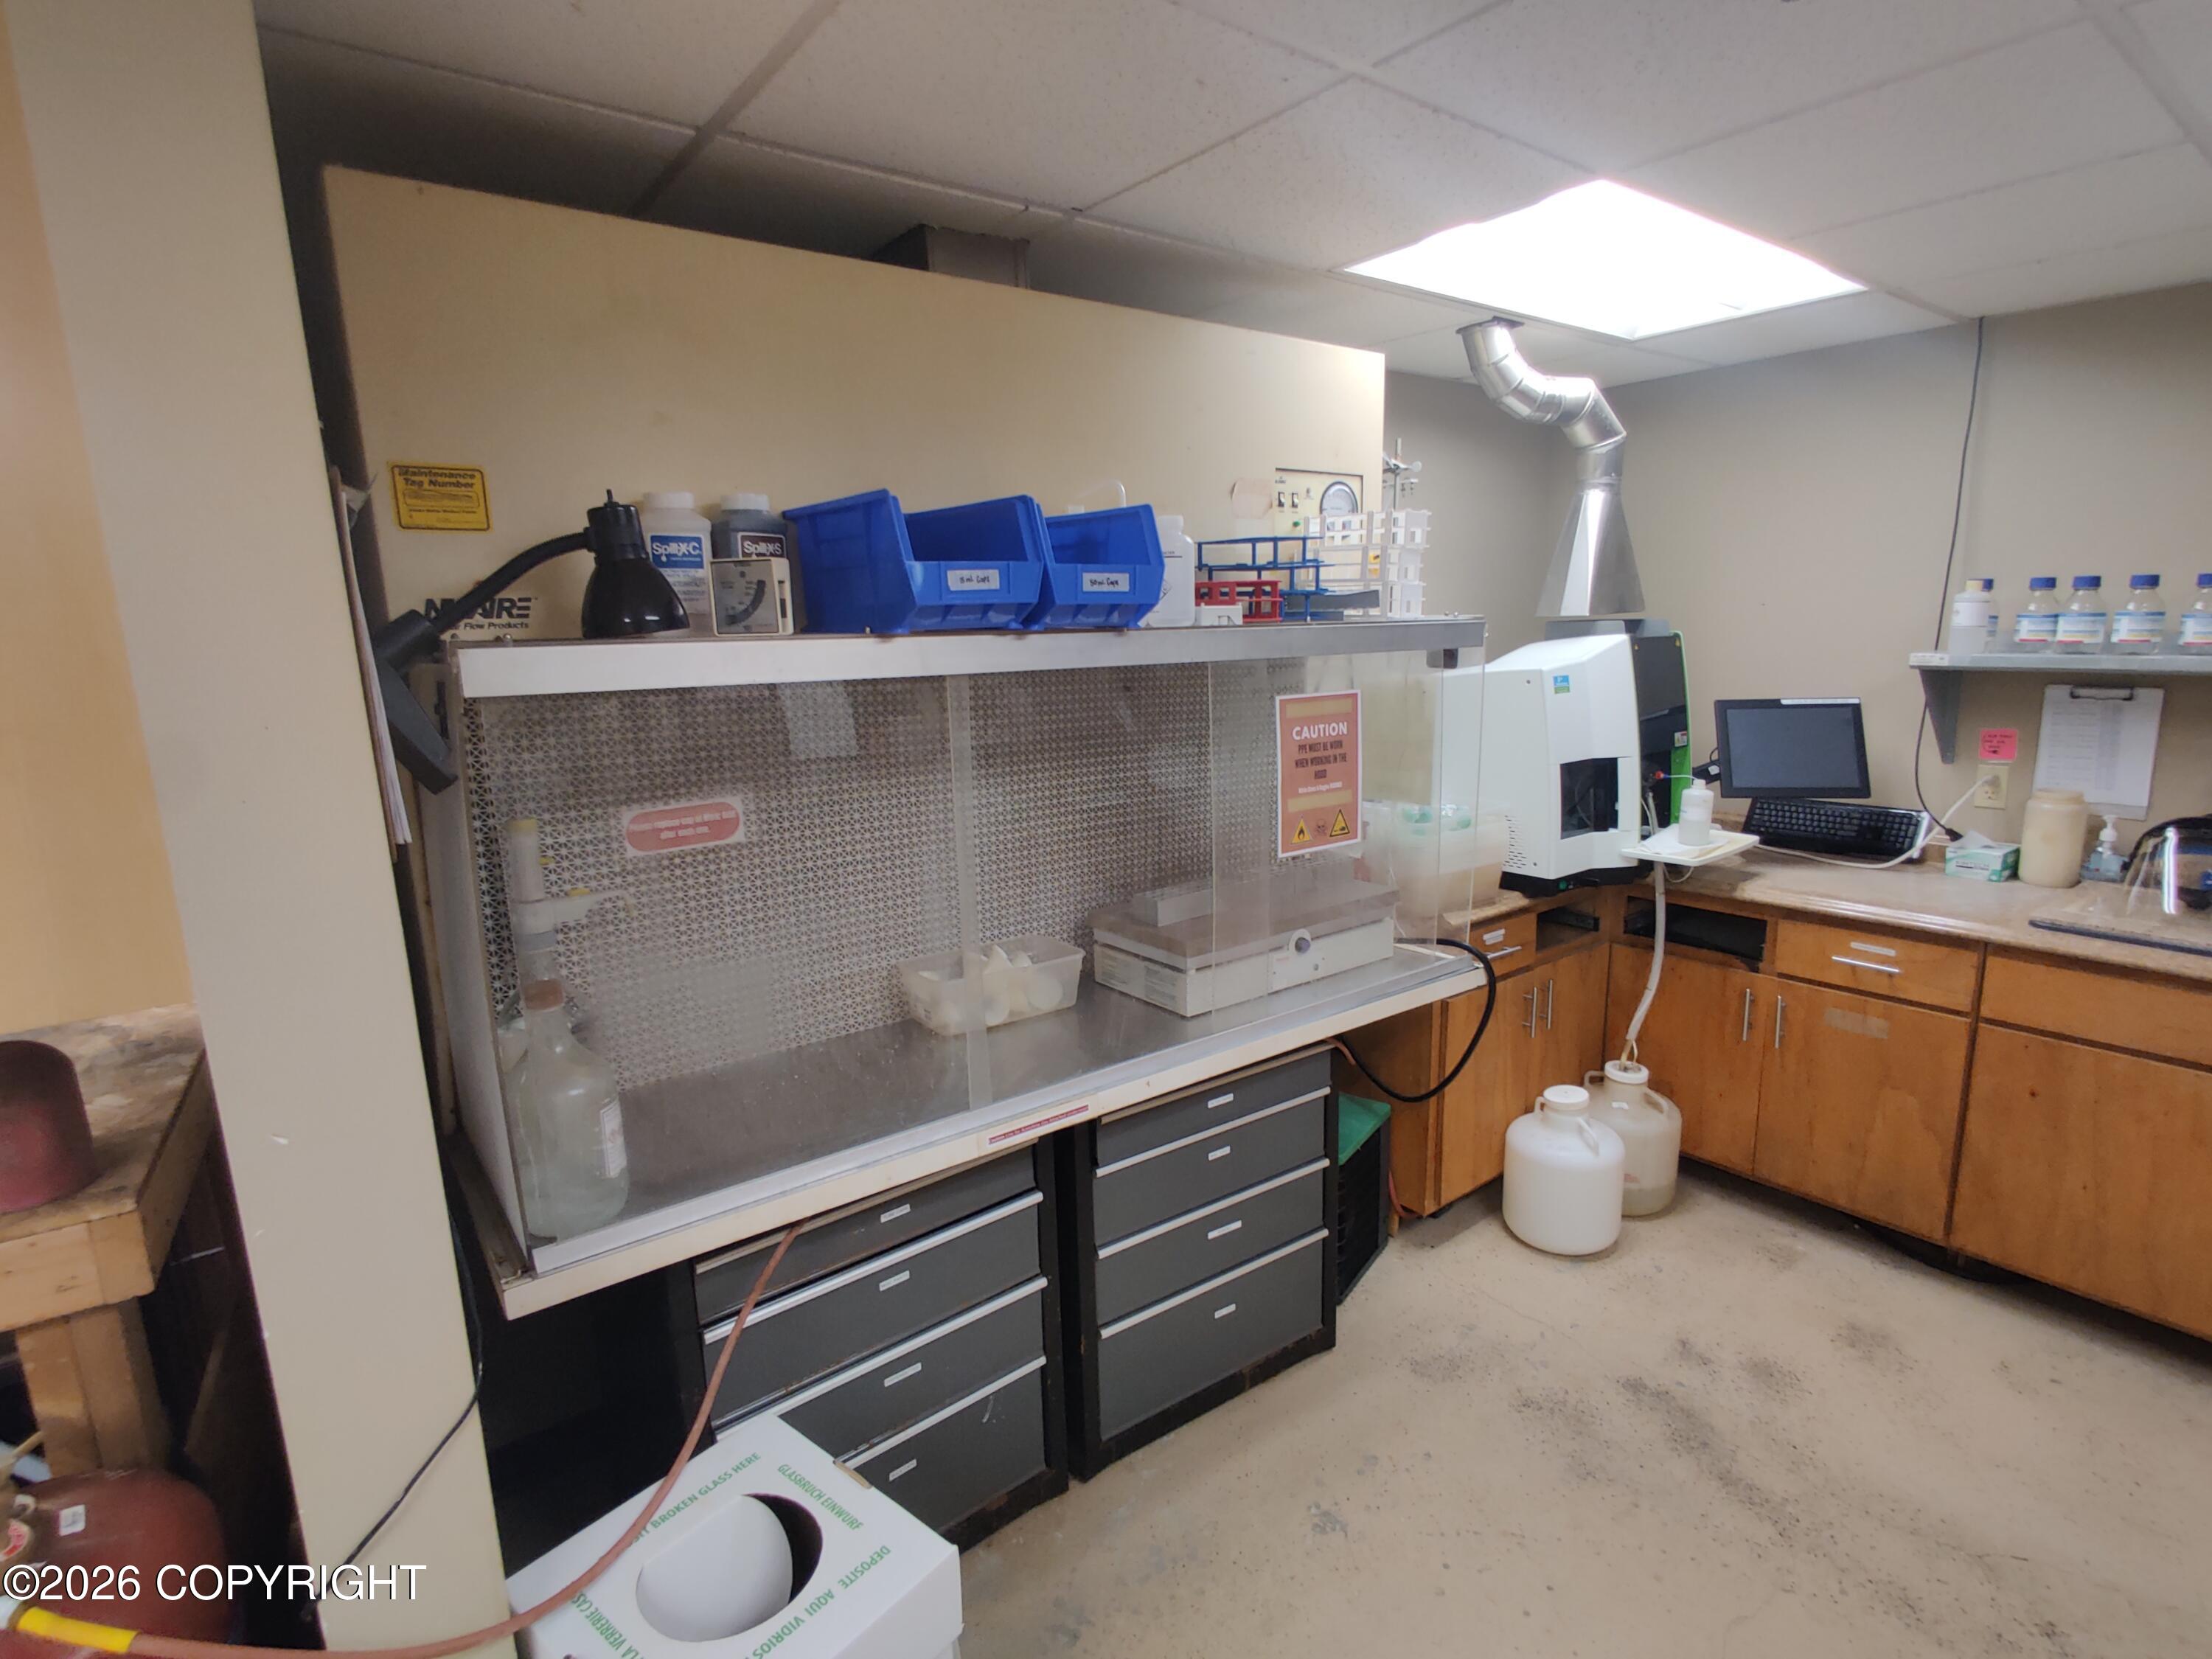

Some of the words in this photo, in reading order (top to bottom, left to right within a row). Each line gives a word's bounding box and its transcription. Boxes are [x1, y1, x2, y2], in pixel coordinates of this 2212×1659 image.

[399, 467, 476, 479] Maintenance
[403, 477, 425, 489] Tag
[428, 479, 476, 488] Number
[425, 598, 532, 619] NAIRE
[487, 621, 529, 630] Products
[1293, 722, 1348, 740] CAUTION
[1298, 744, 1307, 754] PPE
[1309, 742, 1321, 752] MUST
[1323, 741, 1329, 751] BE
[1329, 740, 1343, 750] WORN
[1295, 758, 1309, 768] WHEN
[1310, 754, 1332, 766] WORKING
[1338, 752, 1346, 762] THE
[650, 1495, 698, 1529] BROKEN
[698, 1473, 732, 1497] GLASS
[731, 1453, 761, 1474] HERE
[778, 1464, 826, 1501] GLASBRUCH
[821, 1497, 863, 1530] EINWURF
[838, 1545, 891, 1590] DEPOSITE
[804, 1589, 835, 1616] AQUI
[585, 1607, 627, 1651] VERRERIE
[752, 1616, 805, 1659] VIDRIOS
